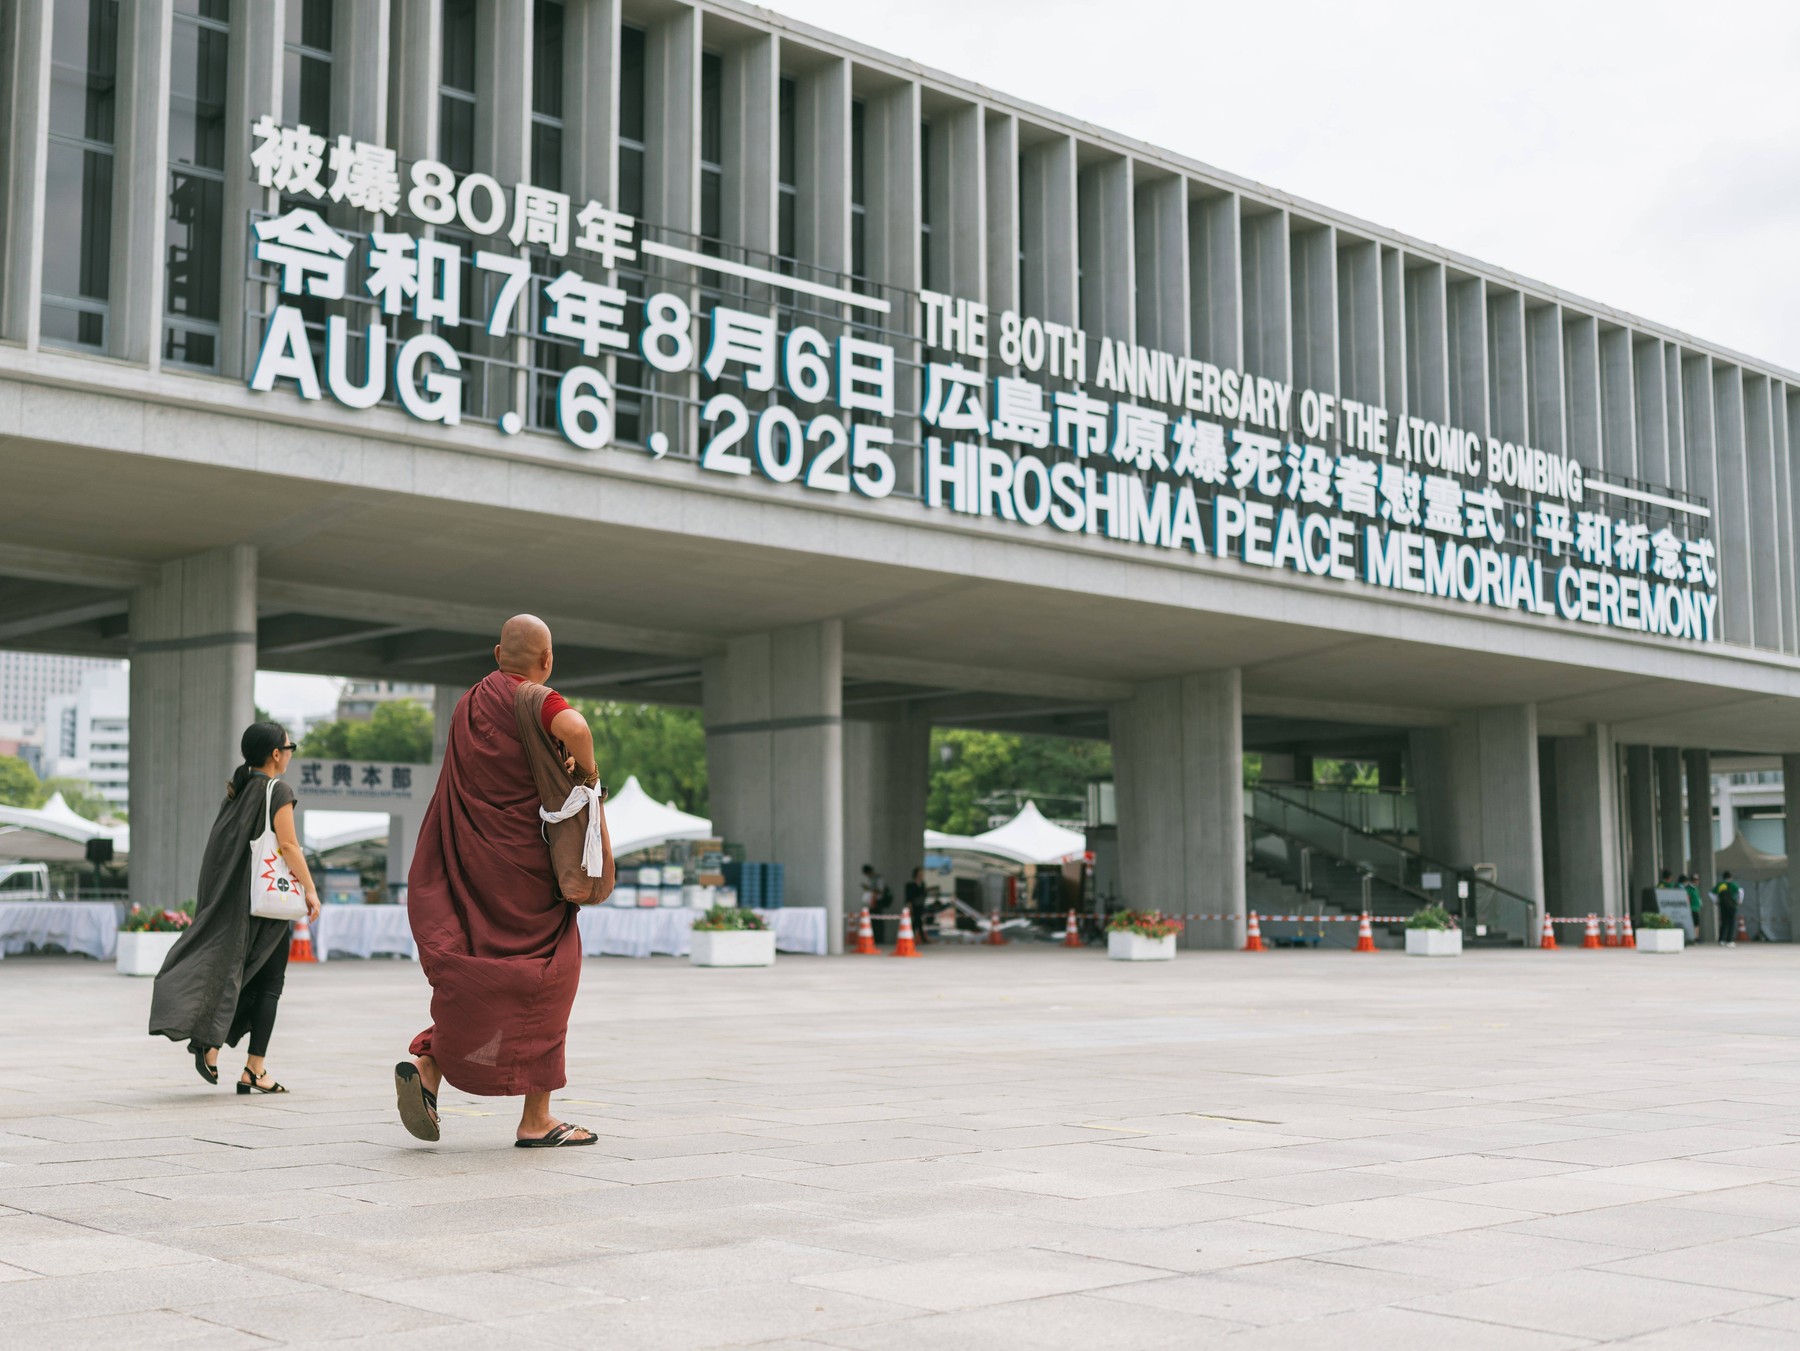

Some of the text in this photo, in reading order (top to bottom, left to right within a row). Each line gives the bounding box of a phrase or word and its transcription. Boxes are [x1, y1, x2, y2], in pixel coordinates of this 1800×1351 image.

[251, 115, 637, 269] 被爆80周年
[253, 208, 895, 417] 令和7年8月6日
[919, 289, 1583, 503] THE 80TH ANNIVERSARY OF THE ATOMIC BOMBING
[701, 393, 896, 498] 2025
[924, 437, 1718, 642] HIROSHIMA PEACE MEMORIAL CEREMONY
[300, 761, 412, 790] 式典本部
